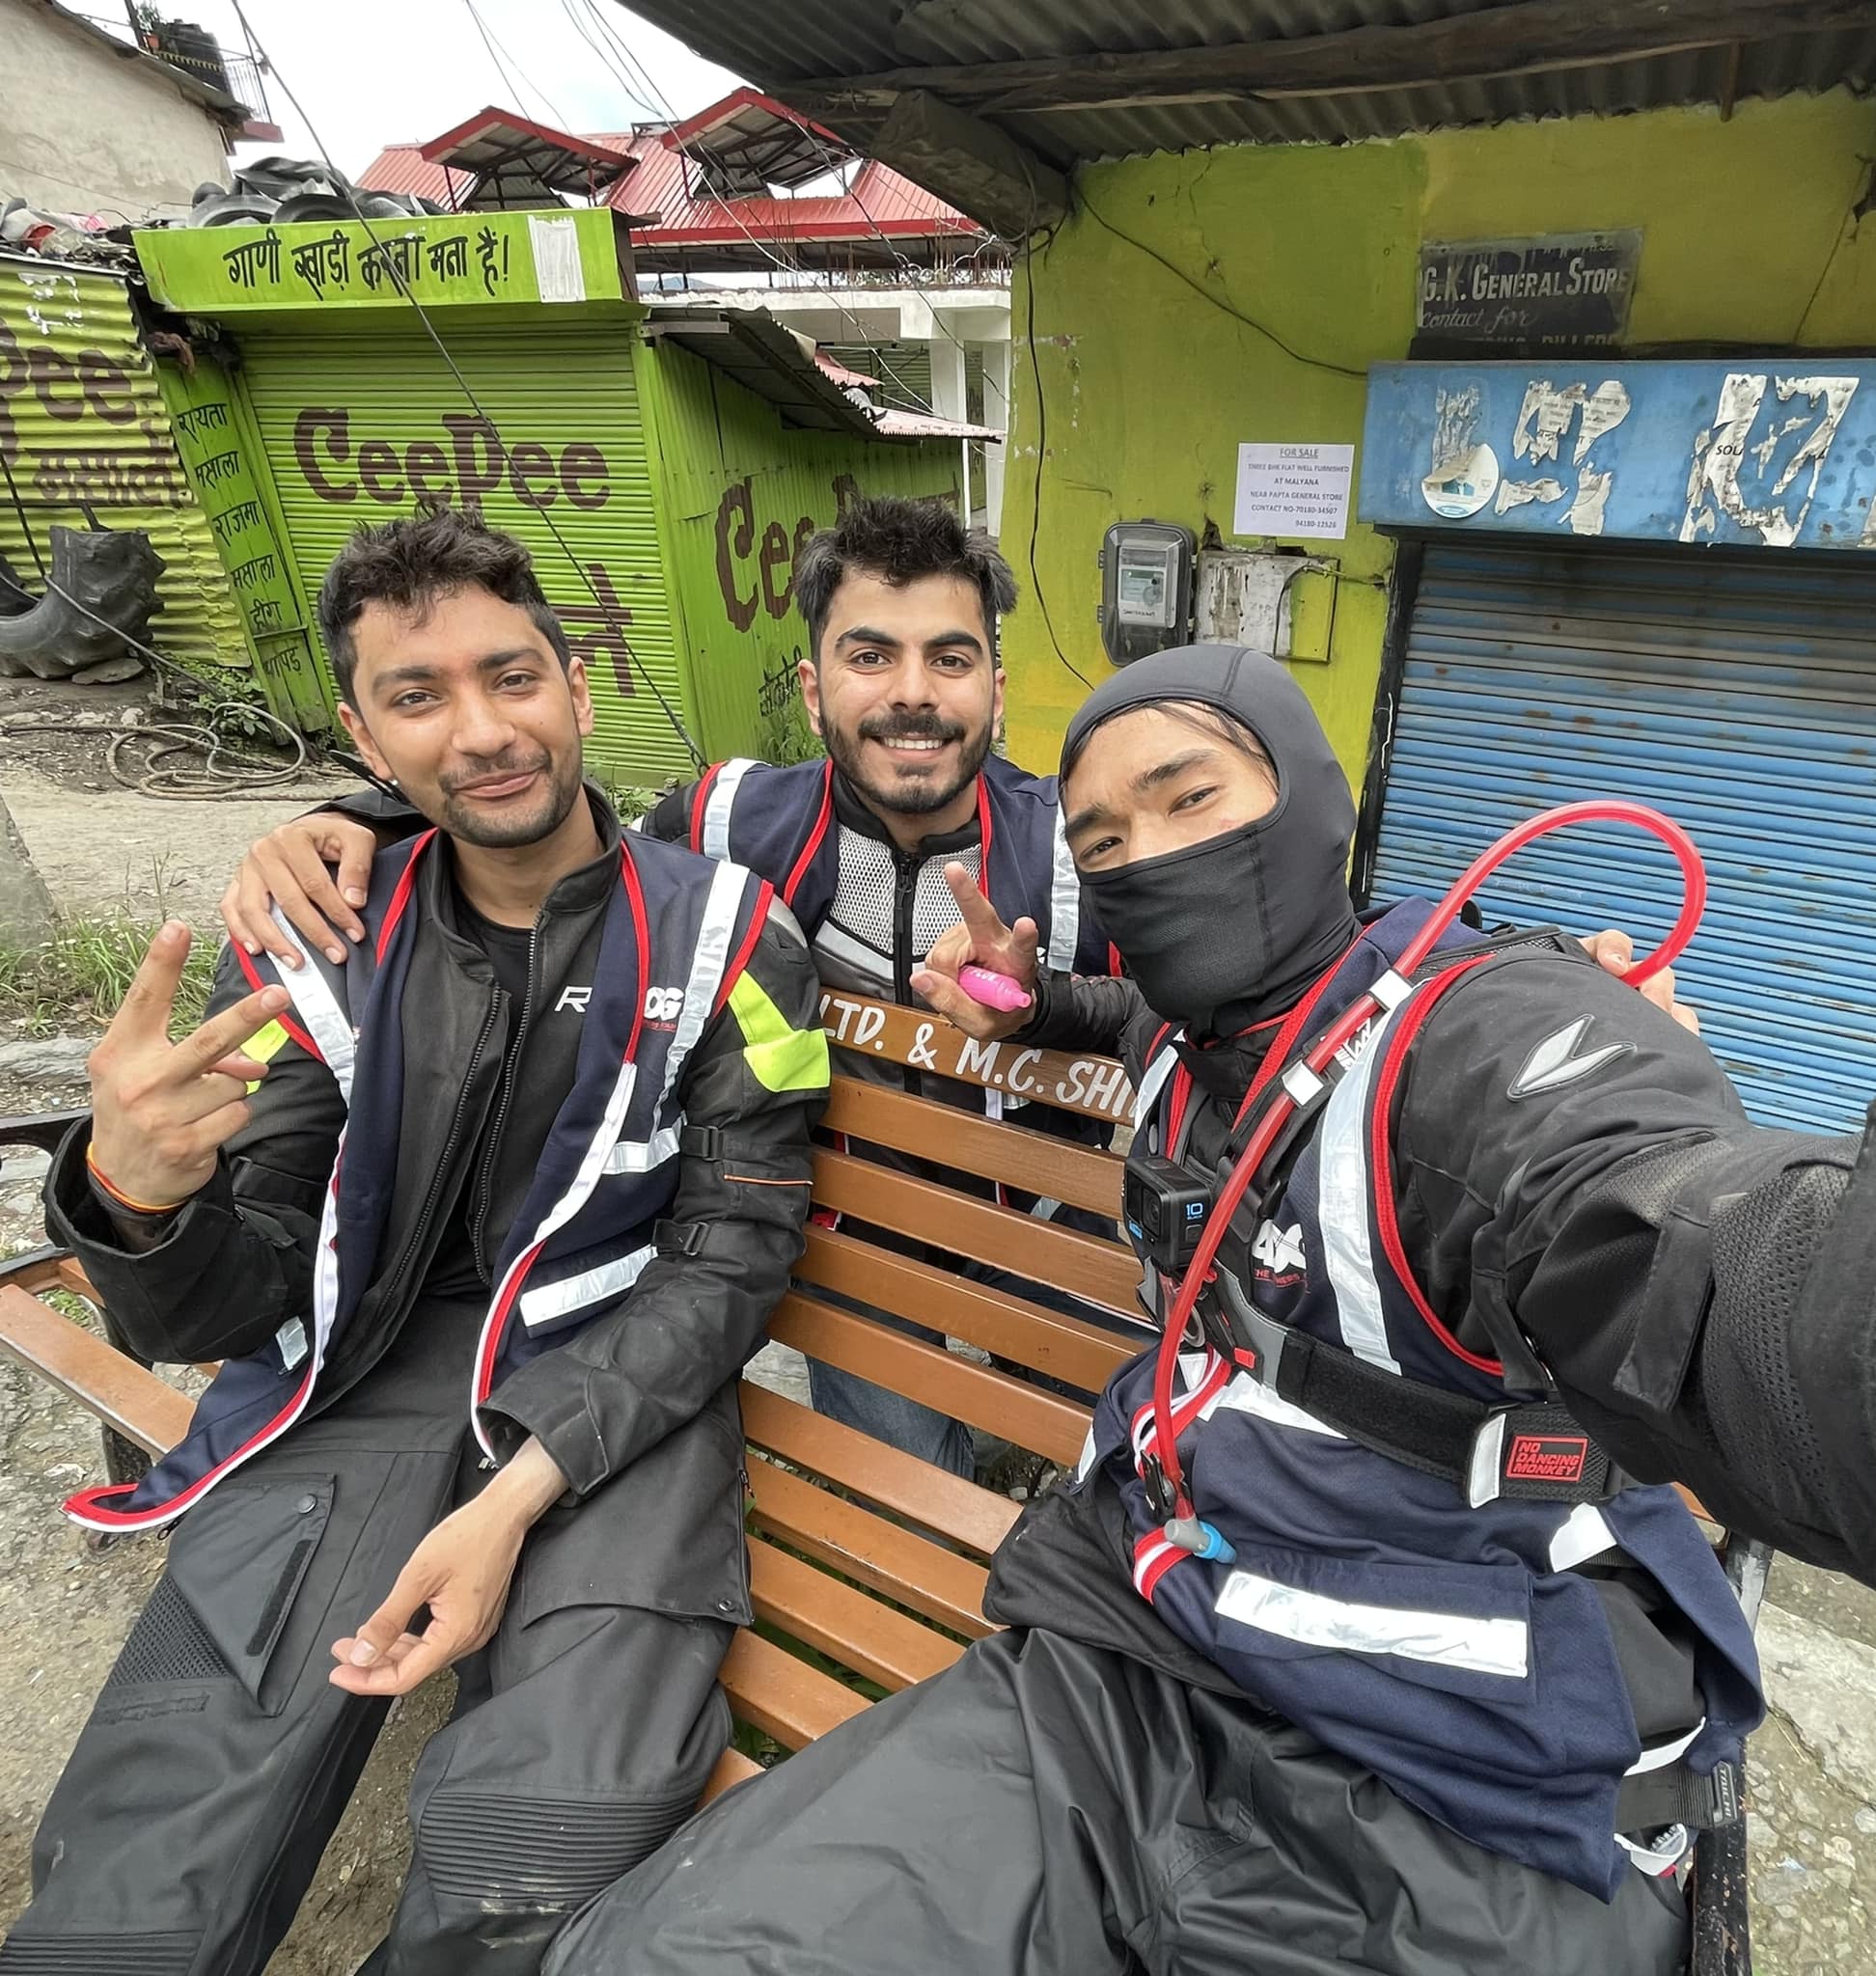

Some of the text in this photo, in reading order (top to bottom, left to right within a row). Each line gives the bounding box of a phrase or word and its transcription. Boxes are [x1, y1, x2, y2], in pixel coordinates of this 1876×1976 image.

[177, 403, 228, 444] रायता
[1280, 448, 1319, 457] FOR SALE
[1251, 504, 1282, 512] CONTACT
[907, 1023, 938, 1071] &
[955, 1037, 1044, 1094] M.C.
[1186, 1202, 1203, 1216] 10
[1518, 1441, 1541, 1453] NO
[1515, 1453, 1581, 1466] DANCING
[1512, 1464, 1577, 1476] MONKEY
